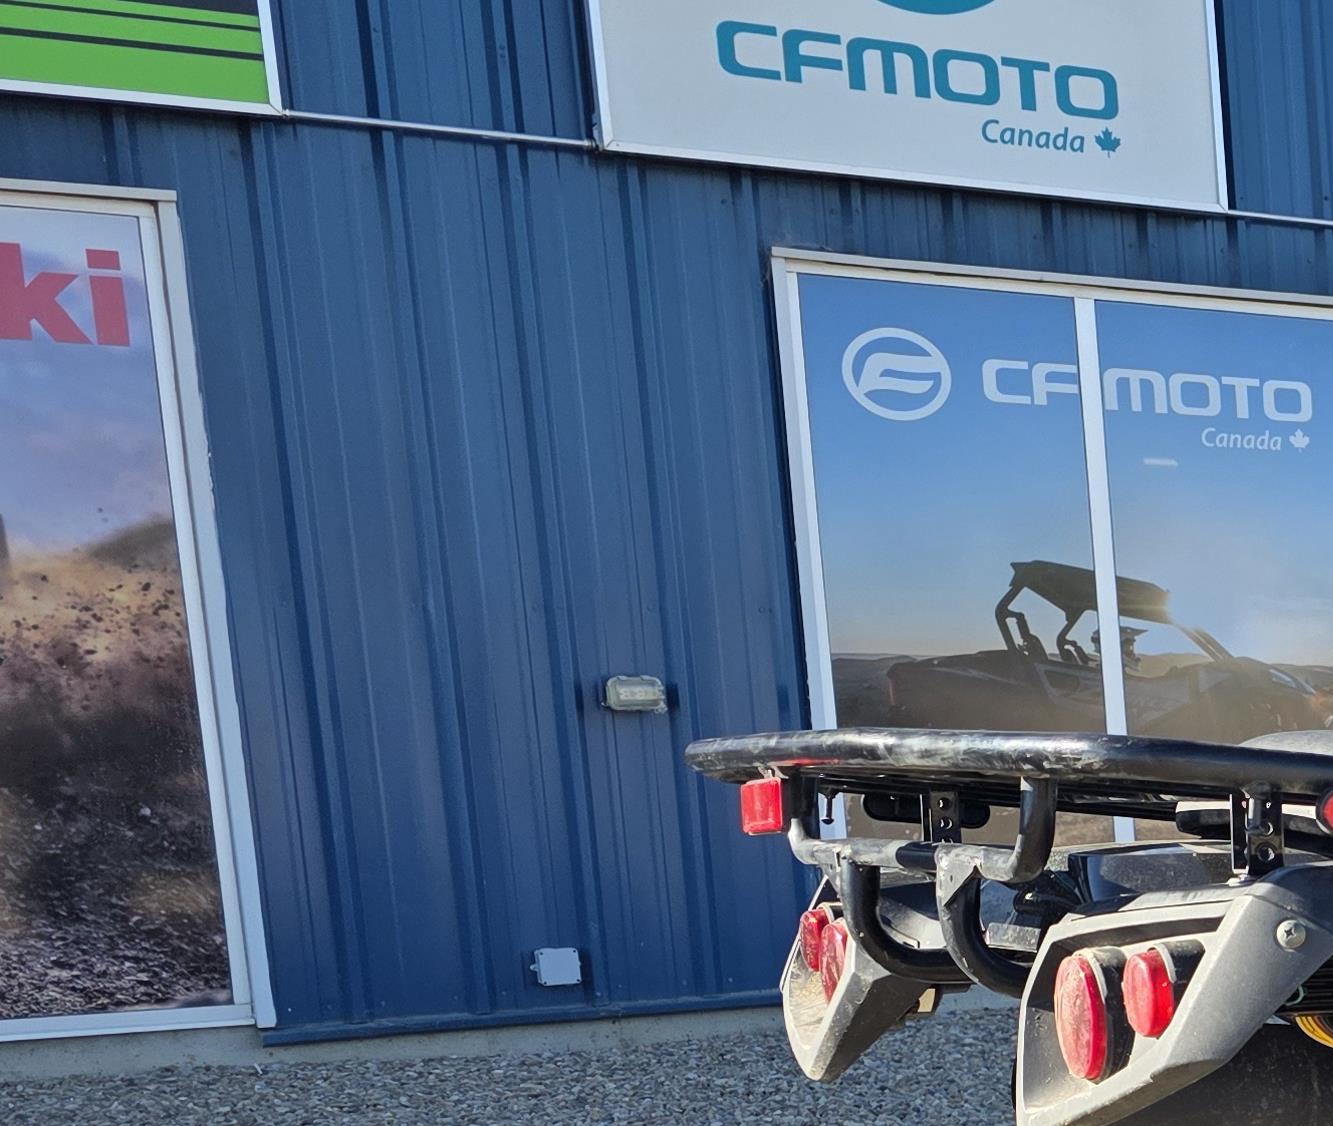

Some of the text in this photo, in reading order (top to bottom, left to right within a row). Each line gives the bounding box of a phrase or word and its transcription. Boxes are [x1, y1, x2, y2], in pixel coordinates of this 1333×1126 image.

[716, 20, 1119, 121] CFMOTO
[981, 118, 1085, 153] Canada
[1200, 427, 1283, 452] Canada
